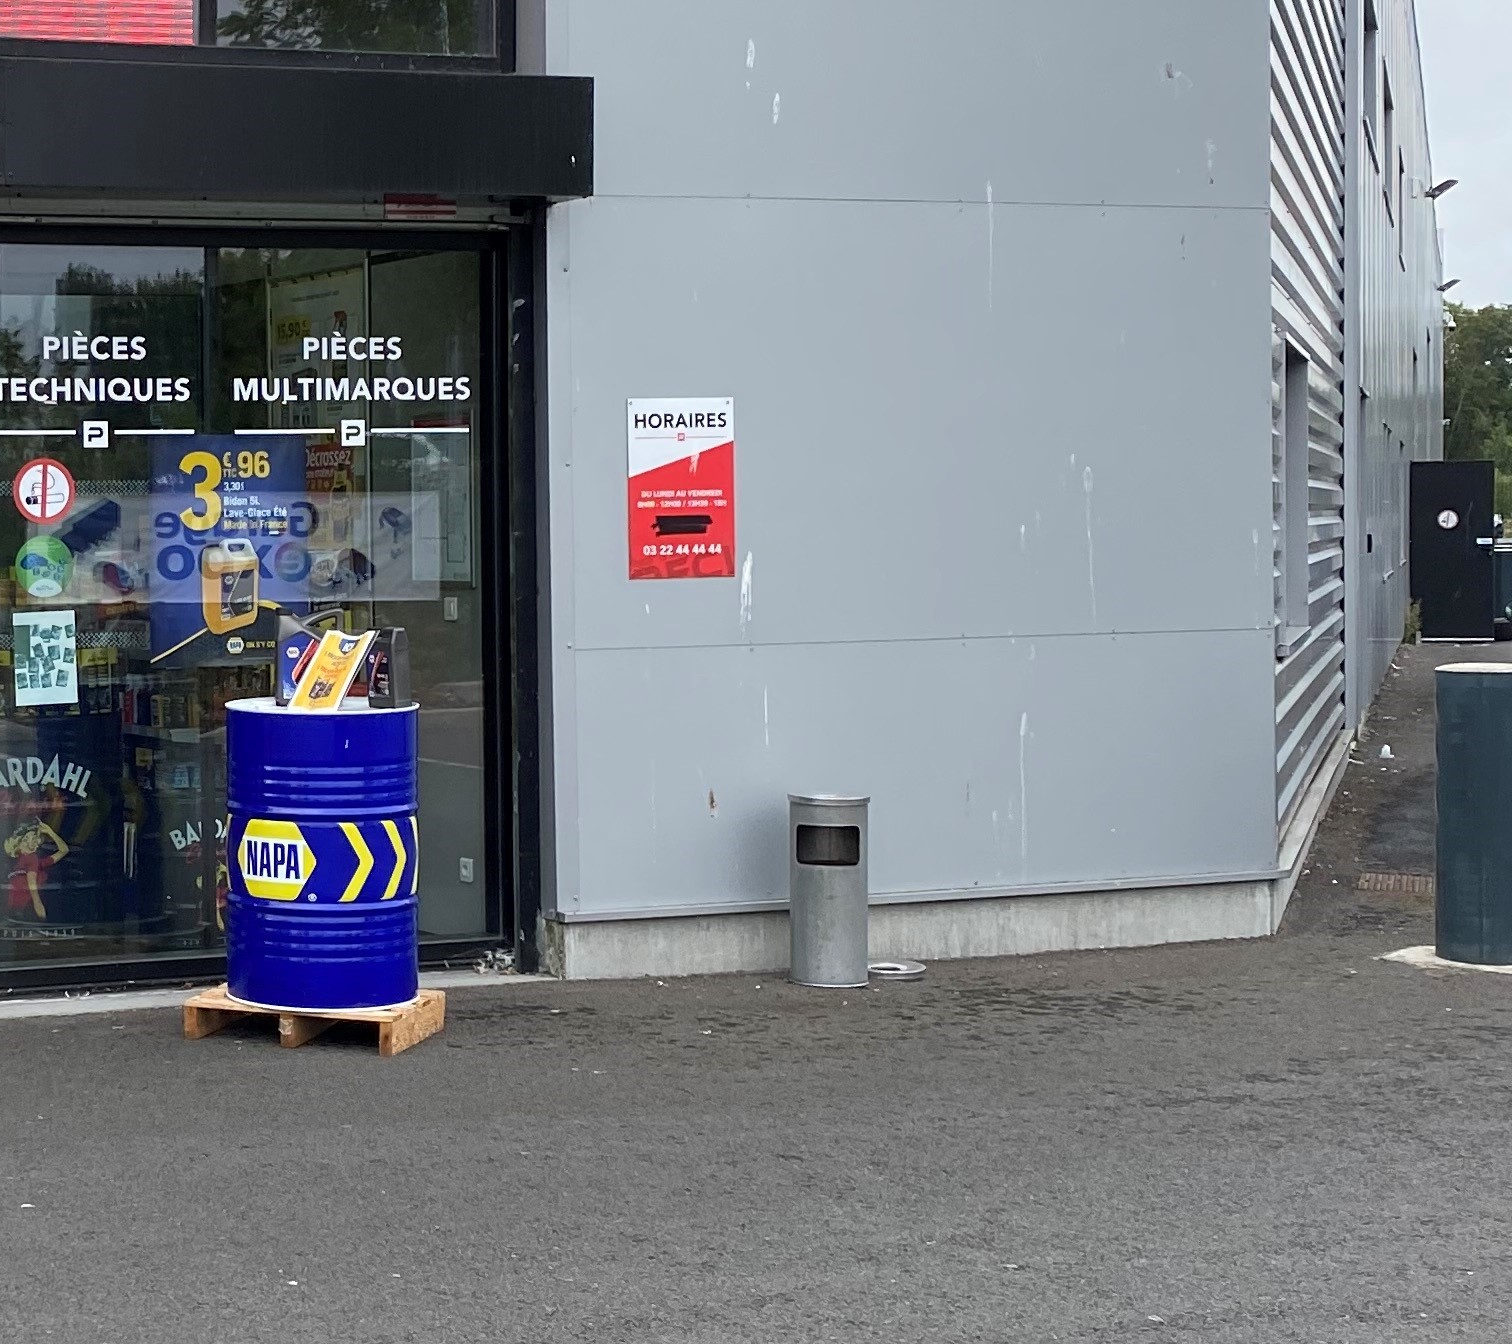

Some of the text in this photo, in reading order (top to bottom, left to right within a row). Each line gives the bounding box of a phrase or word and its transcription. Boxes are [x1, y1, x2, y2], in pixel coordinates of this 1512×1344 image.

[42, 330, 146, 360] PIÈCES
[303, 331, 402, 360] PIÈCES
[233, 376, 471, 403] MULTIMARQUES
[634, 412, 728, 429] HORAIRES
[223, 468, 237, 478] TTC
[179, 451, 222, 531] 3
[238, 451, 271, 478] 96
[223, 496, 260, 506] Bidon 5L
[223, 505, 288, 518] Lave-Glace Été
[223, 520, 247, 529] Made
[259, 519, 288, 529] France
[643, 543, 722, 556] 03 22 44 44 44
[247, 840, 300, 880] NAPA
